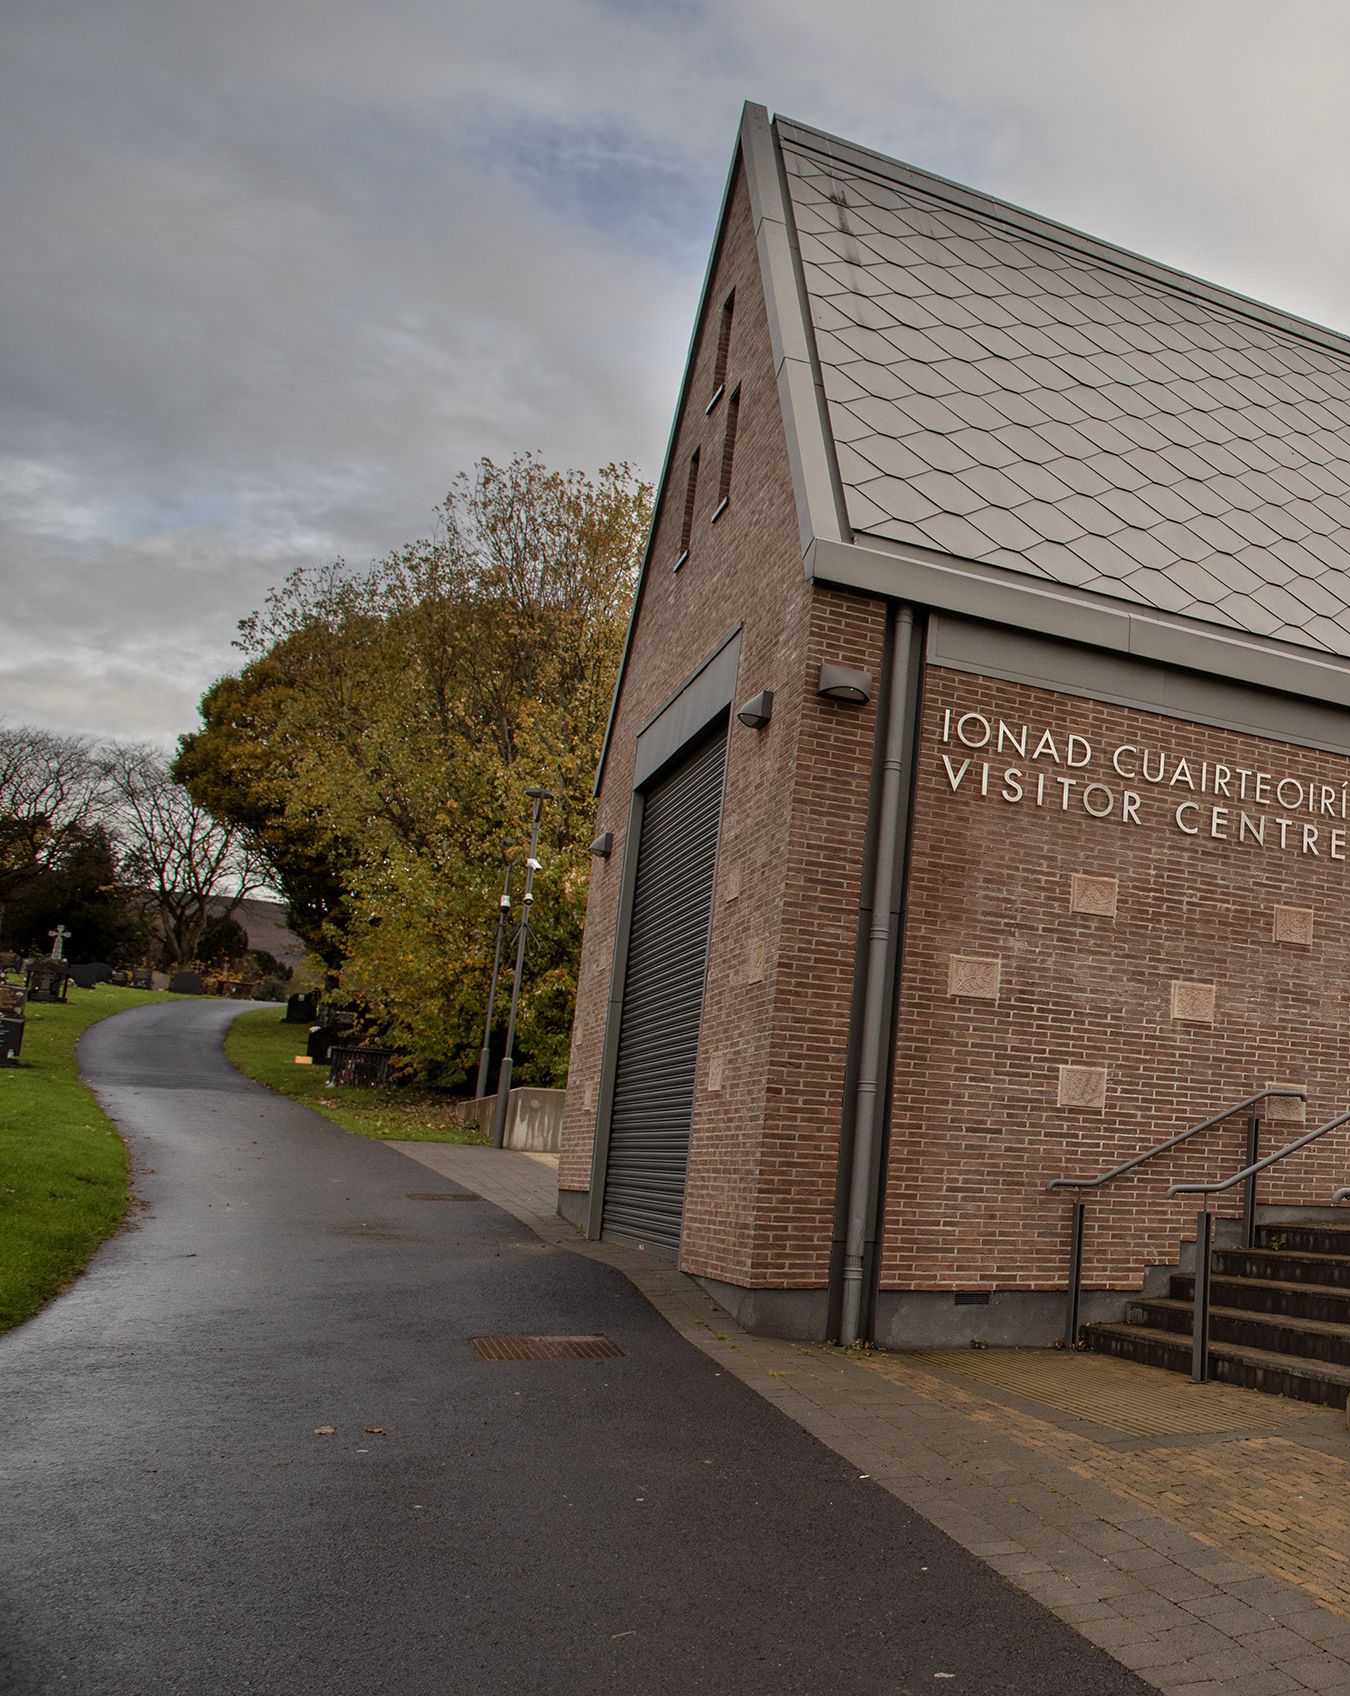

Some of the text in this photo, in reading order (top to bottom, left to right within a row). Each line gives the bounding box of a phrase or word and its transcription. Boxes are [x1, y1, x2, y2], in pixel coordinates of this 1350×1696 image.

[942, 754, 1346, 860] VISITOR CENTRE
[943, 709, 1348, 818] IONAD CUAIRTEOIRÍ
